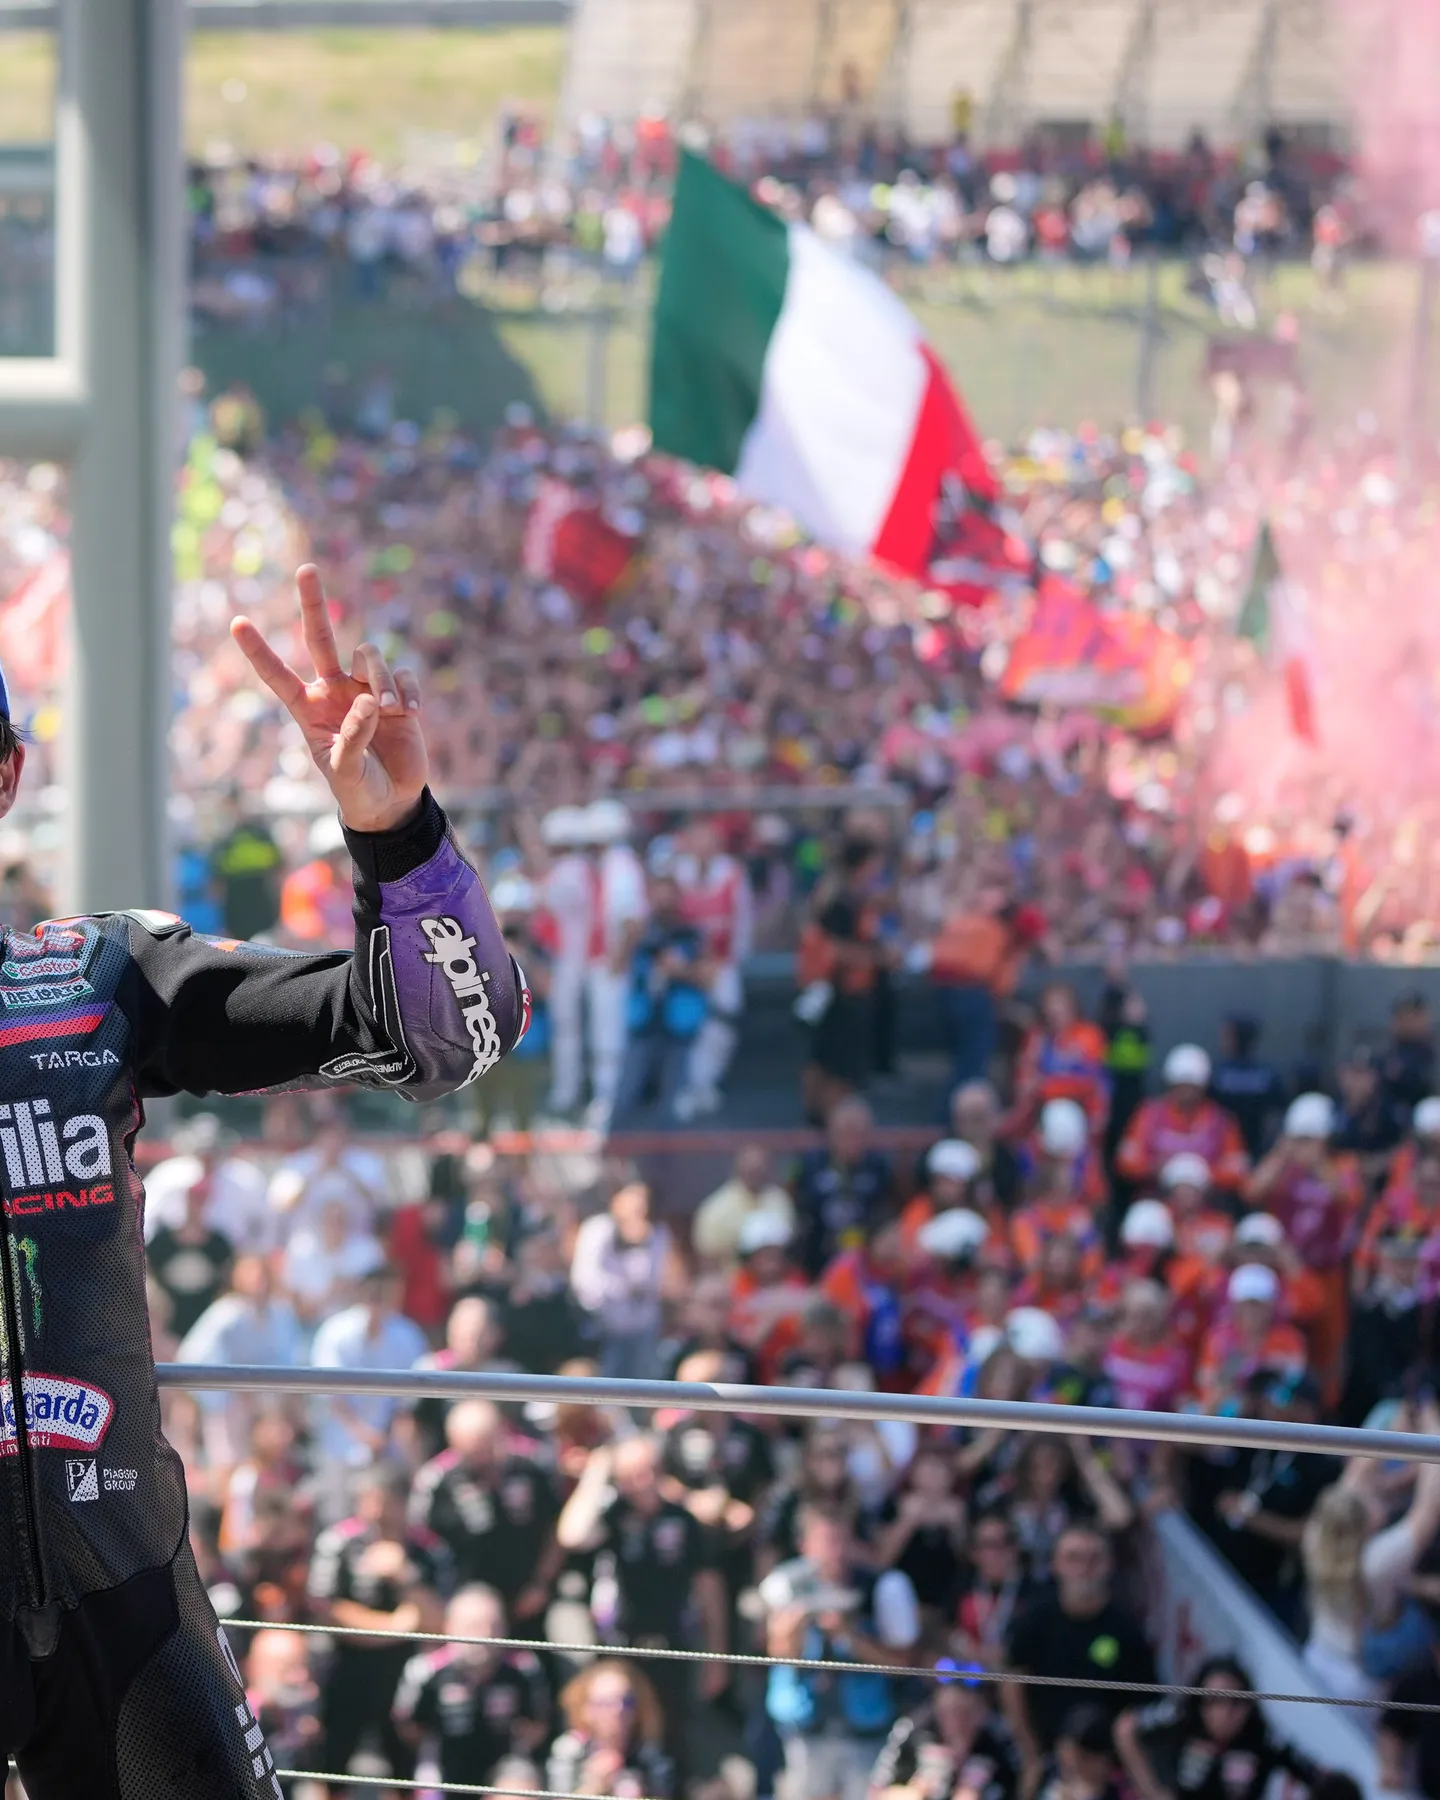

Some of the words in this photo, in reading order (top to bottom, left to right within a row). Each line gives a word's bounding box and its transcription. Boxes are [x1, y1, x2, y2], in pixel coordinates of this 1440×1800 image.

[30, 1049, 119, 1070] TARGA
[103, 1468, 138, 1480] PIAGGIO
[103, 1480, 136, 1491] GROUP
